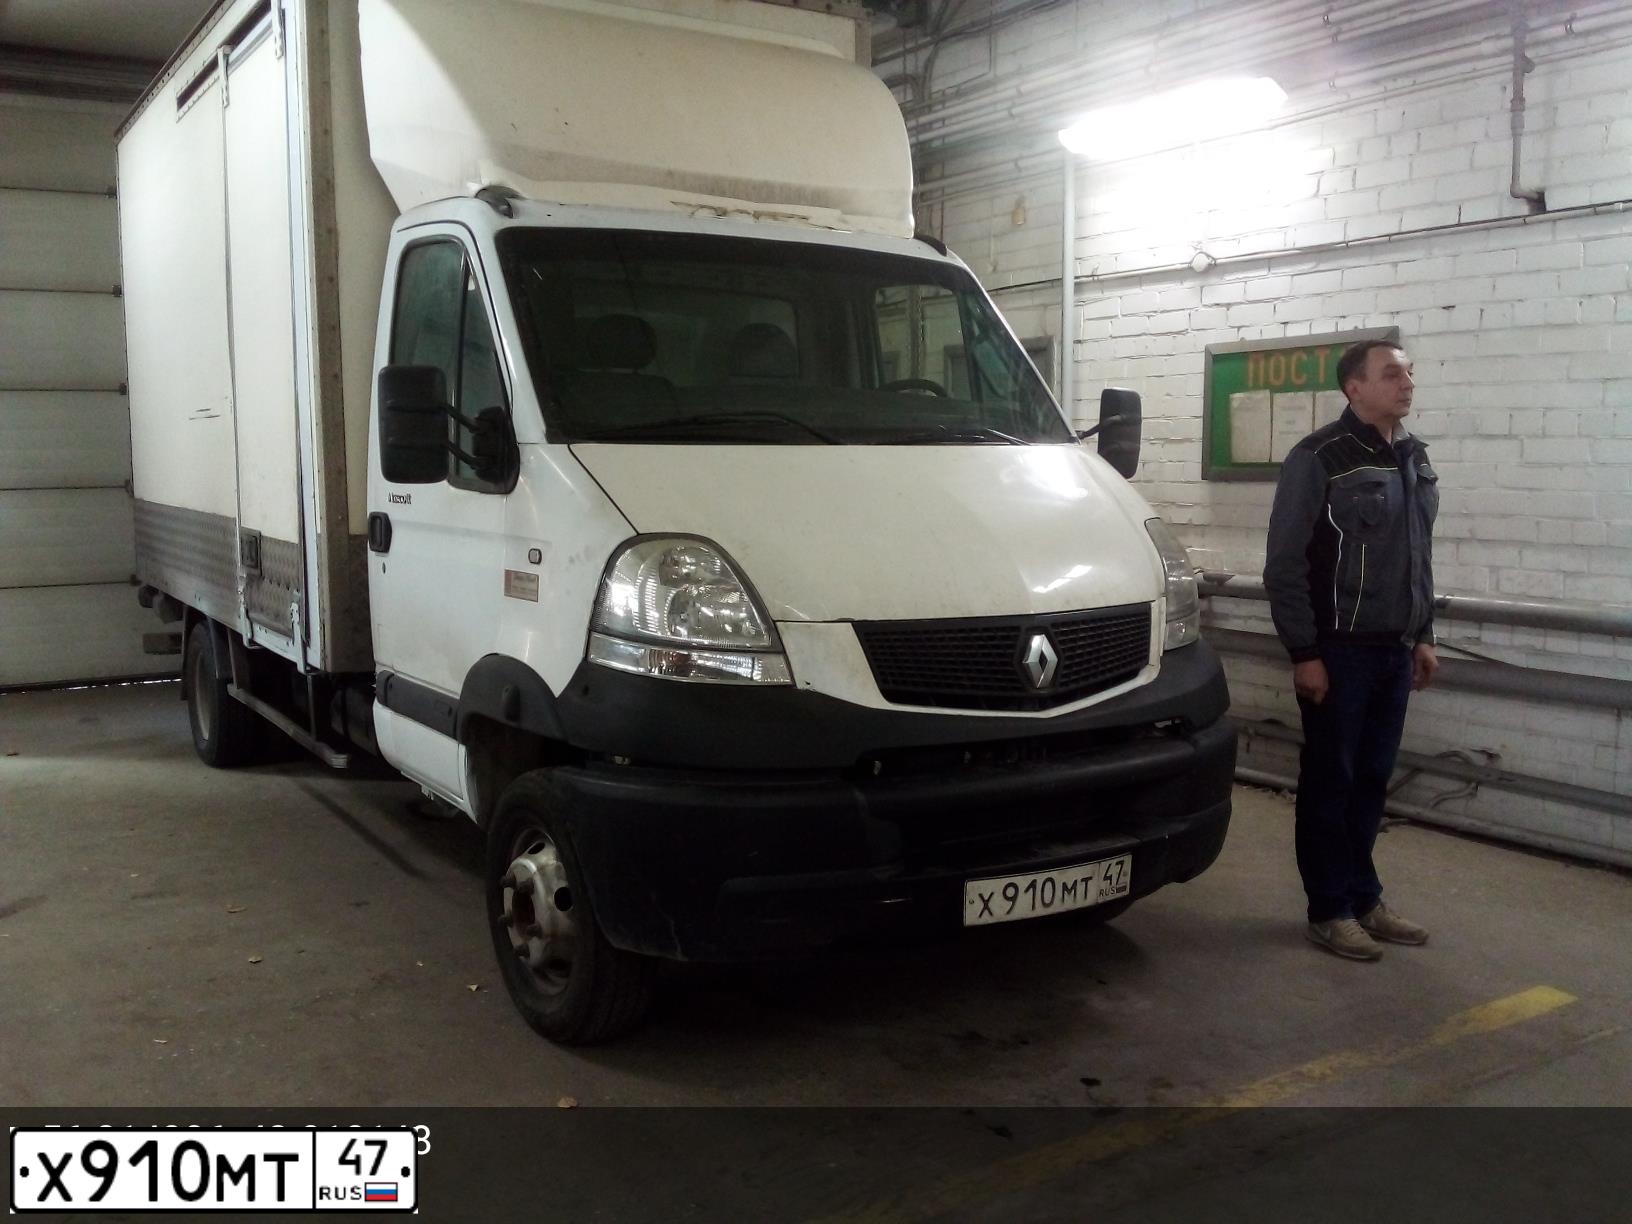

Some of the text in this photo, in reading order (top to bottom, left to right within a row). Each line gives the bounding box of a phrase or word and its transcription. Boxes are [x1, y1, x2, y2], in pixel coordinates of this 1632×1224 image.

[1249, 349, 1331, 386] ПОСТ
[978, 861, 1125, 918] Х910МТ 47
[1100, 886, 1117, 897] RUS
